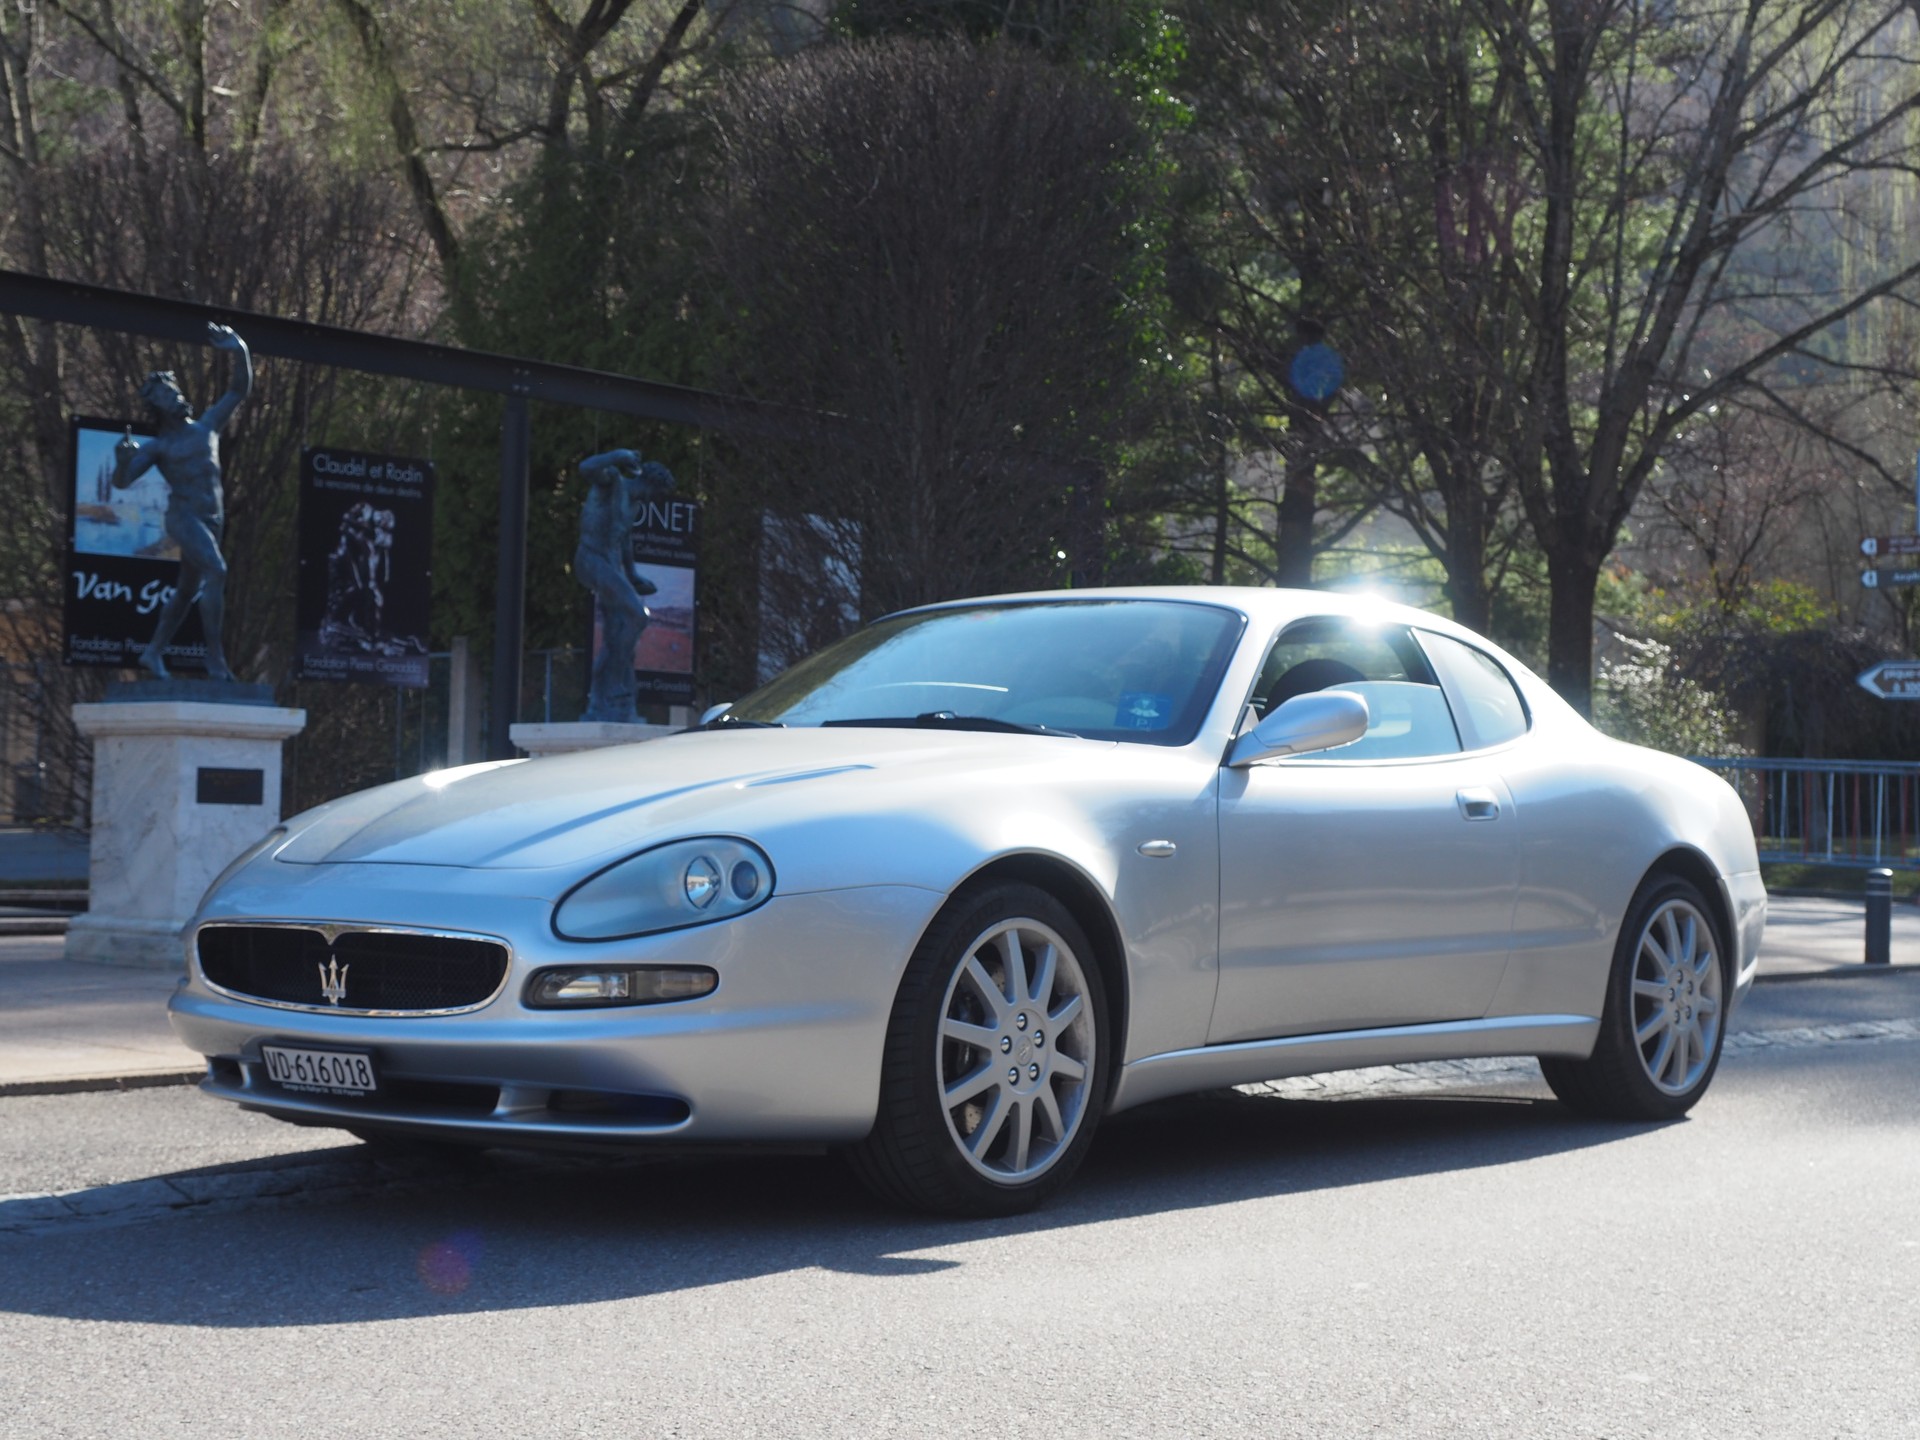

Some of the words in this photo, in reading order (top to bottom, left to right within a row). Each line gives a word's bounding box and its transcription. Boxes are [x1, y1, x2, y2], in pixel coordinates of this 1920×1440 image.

[312, 453, 366, 477] Claudel
[386, 462, 424, 483] Rodin
[632, 500, 698, 533] ONET
[72, 571, 132, 602] Van
